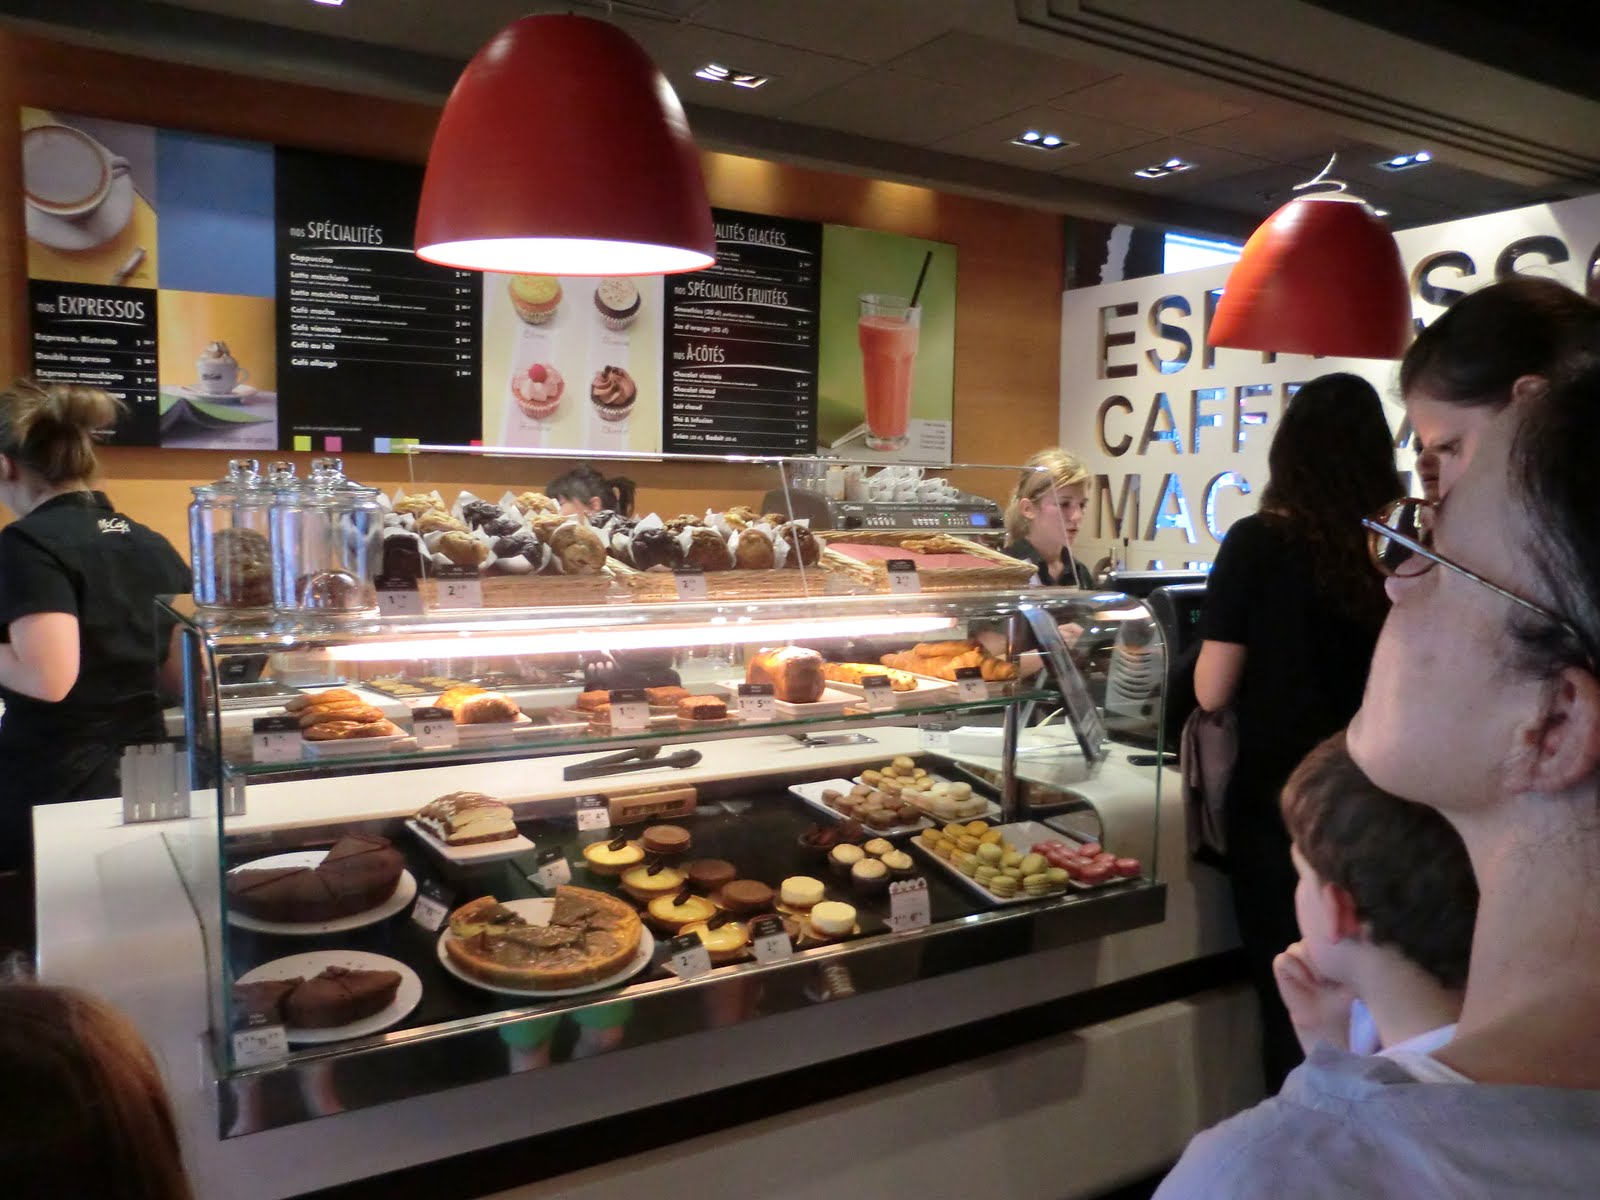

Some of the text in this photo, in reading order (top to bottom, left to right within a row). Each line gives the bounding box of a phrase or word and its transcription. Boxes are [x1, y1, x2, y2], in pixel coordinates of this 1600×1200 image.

[290, 220, 383, 246] nos SPÉCIALITÉS
[748, 228, 787, 247] GLACÉES
[290, 253, 334, 265] Cappuccino
[290, 271, 350, 283] Latte macchiato
[290, 288, 380, 302] Latte macchiato caramel
[687, 279, 745, 301] SPÉCIALITÉS
[746, 288, 789, 307] FRUITÉES
[58, 295, 146, 320] EXPRESSOS
[290, 305, 309, 315] Café
[290, 323, 342, 334] Café viennois
[290, 340, 310, 350] Café
[686, 343, 726, 363] À-CÔTÉS
[290, 357, 309, 366] Café
[673, 370, 699, 379] Chocolat
[672, 386, 698, 395] Chocolat
[1095, 382, 1304, 458] CAFF
[1095, 471, 1252, 544] MAC
